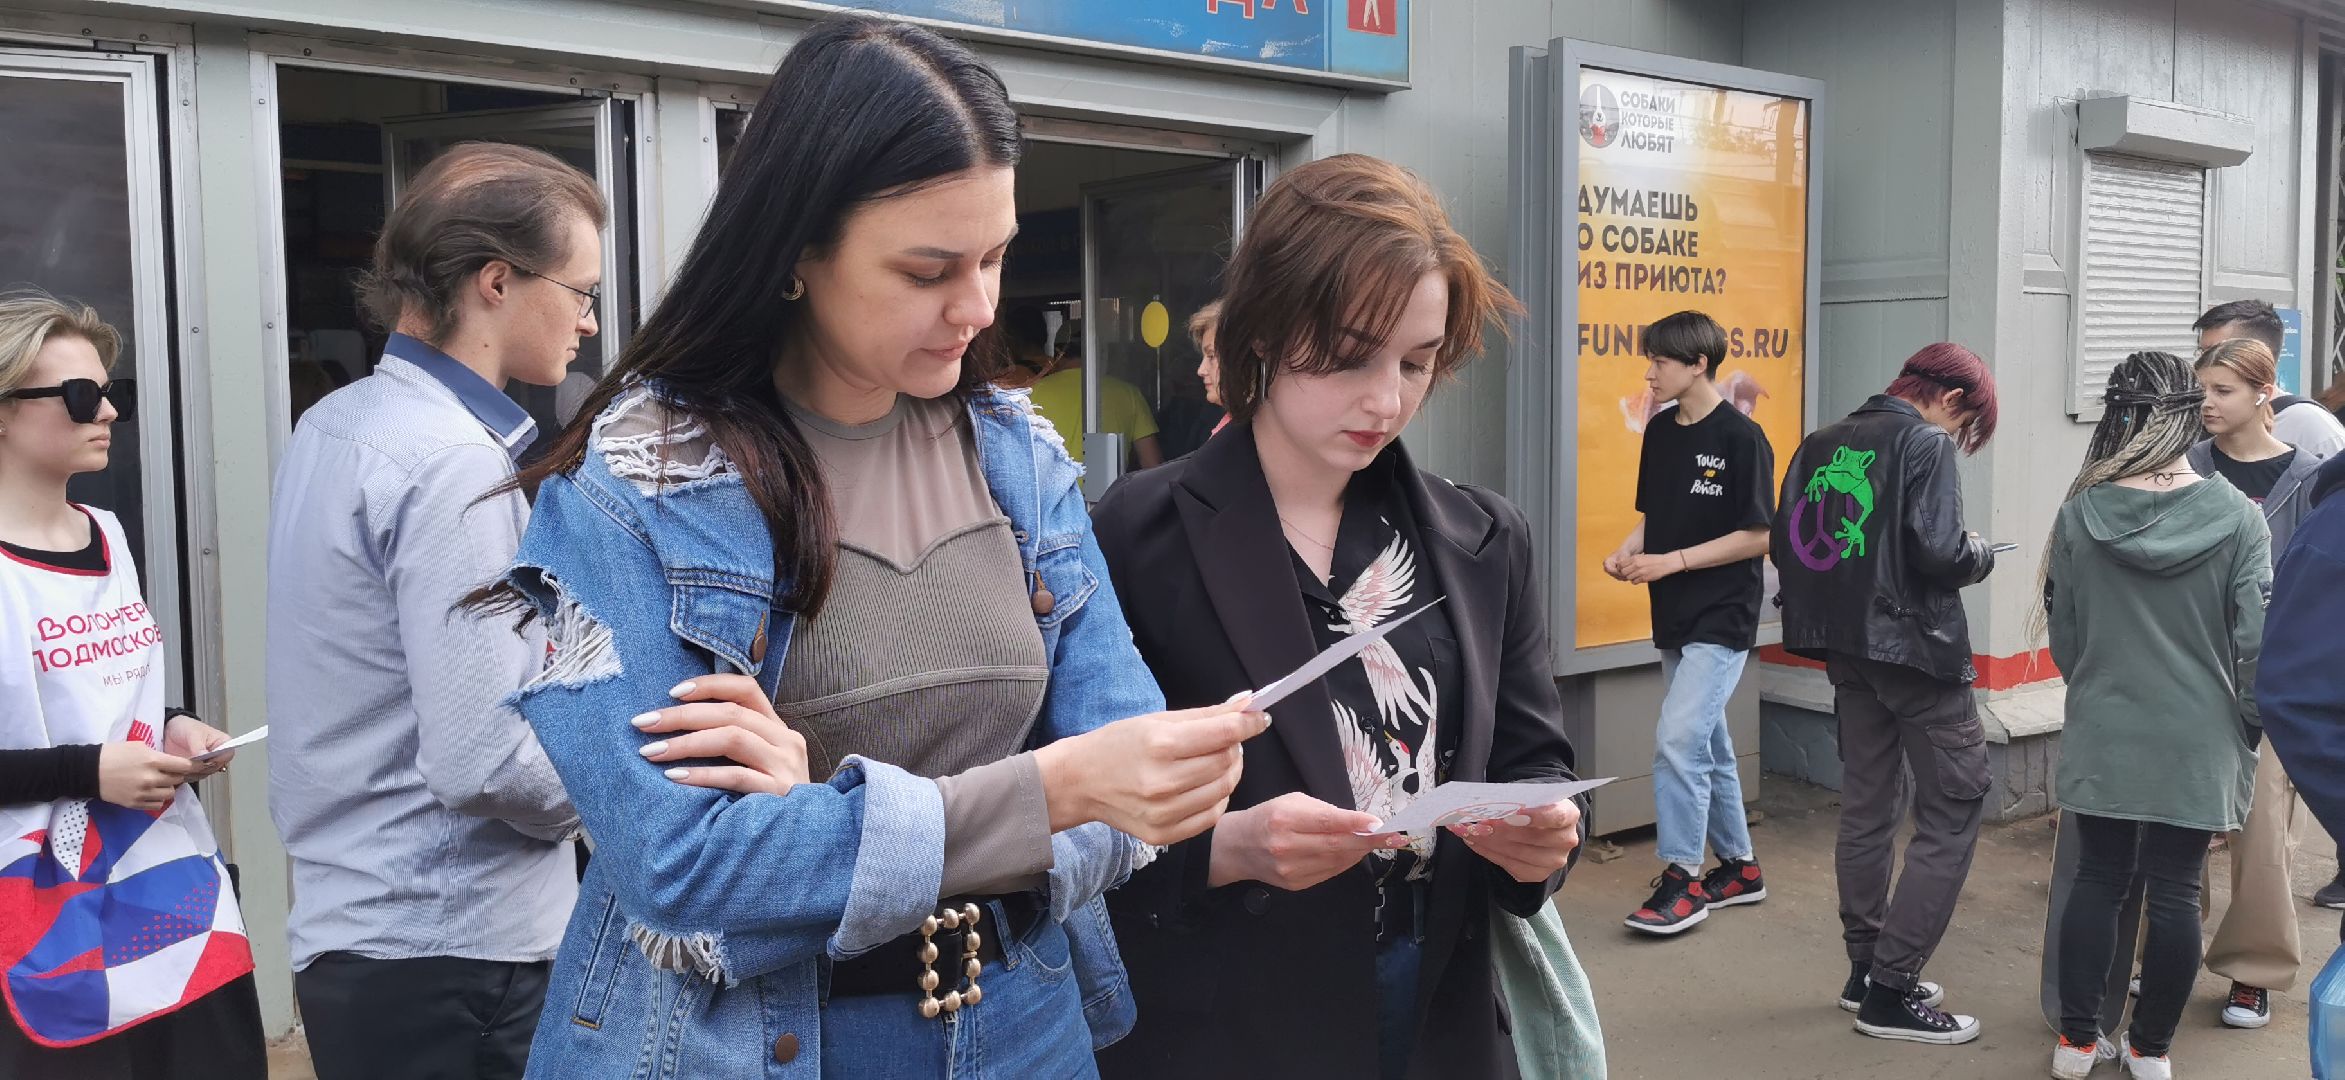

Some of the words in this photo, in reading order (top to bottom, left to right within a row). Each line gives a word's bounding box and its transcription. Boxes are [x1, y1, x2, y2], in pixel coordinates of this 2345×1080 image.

[1620, 91, 1675, 113] СОБАКИ
[1621, 111, 1674, 131] КОТОРЫЕ
[1620, 130, 1675, 153] ЛЮБЯТ
[1578, 184, 1698, 221] ДУМАЕШЬ
[1578, 222, 1594, 250] О
[1602, 225, 1698, 258] СОБАКЕ
[1578, 260, 1607, 289] ИЗ
[1615, 262, 1727, 295] ПРИЮТА?
